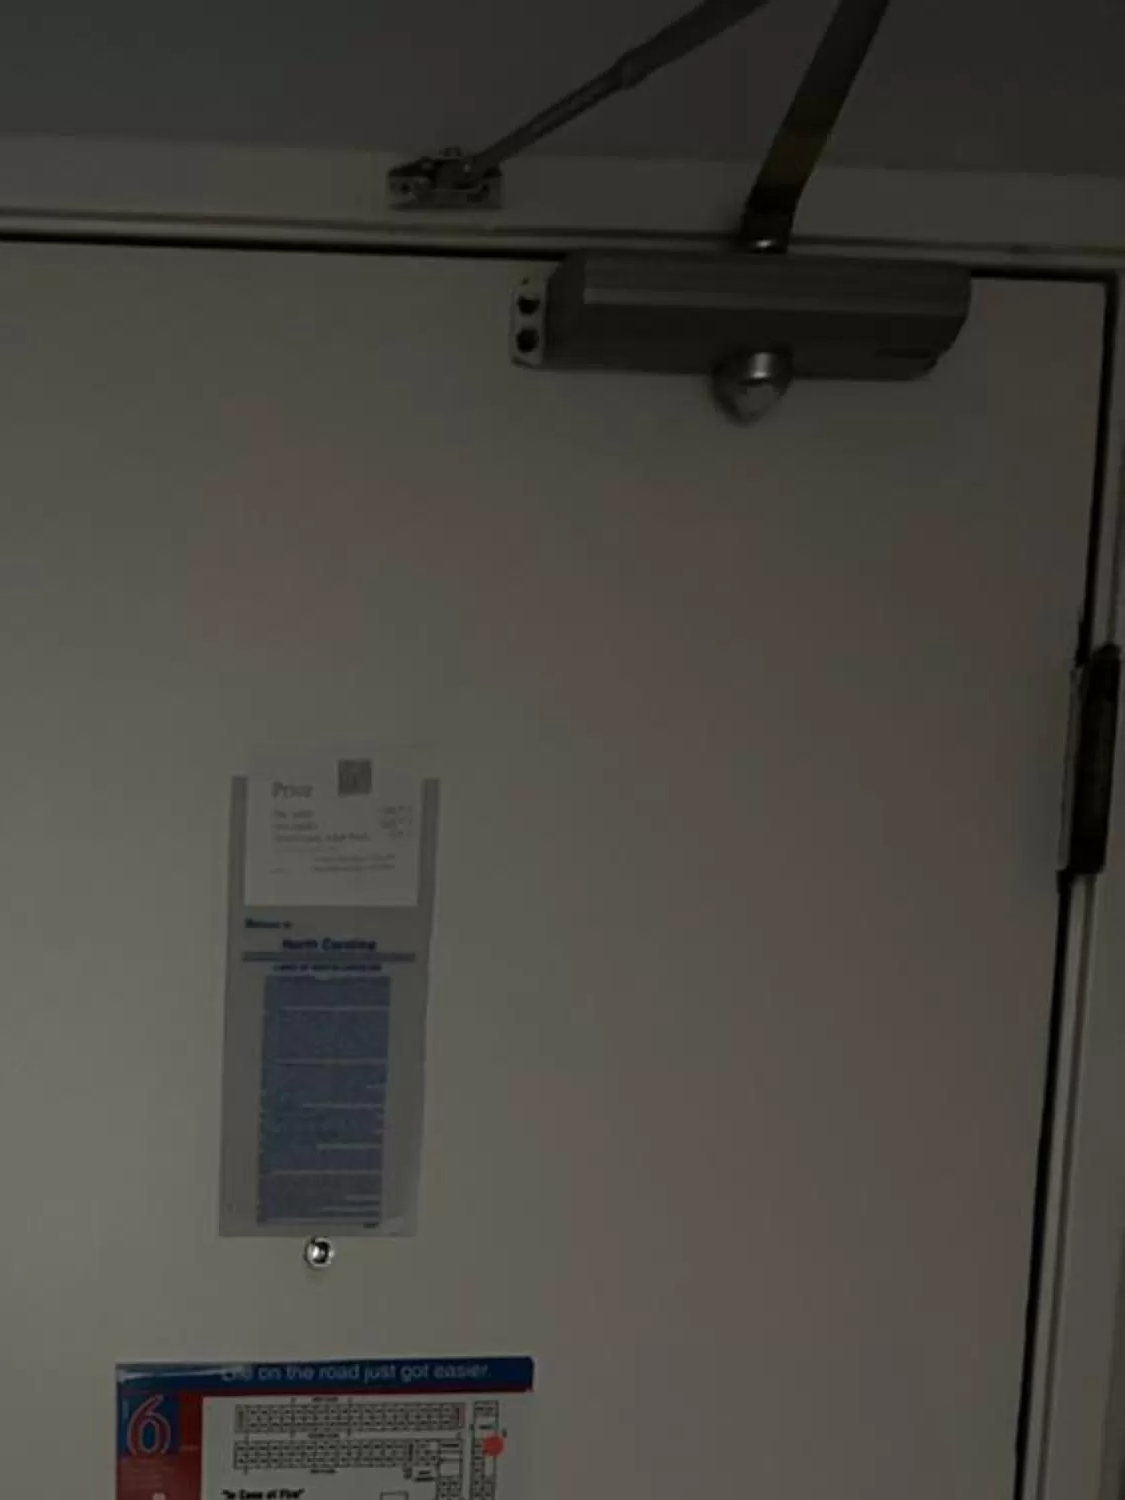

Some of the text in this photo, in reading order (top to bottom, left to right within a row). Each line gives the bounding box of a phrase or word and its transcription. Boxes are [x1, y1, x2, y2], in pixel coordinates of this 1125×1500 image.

[258, 1366, 283, 1381] on
[286, 1364, 315, 1381] the
[318, 1363, 360, 1380] road
[363, 1362, 396, 1384] just
[400, 1362, 430, 1383] got
[126, 1393, 173, 1457] 6
